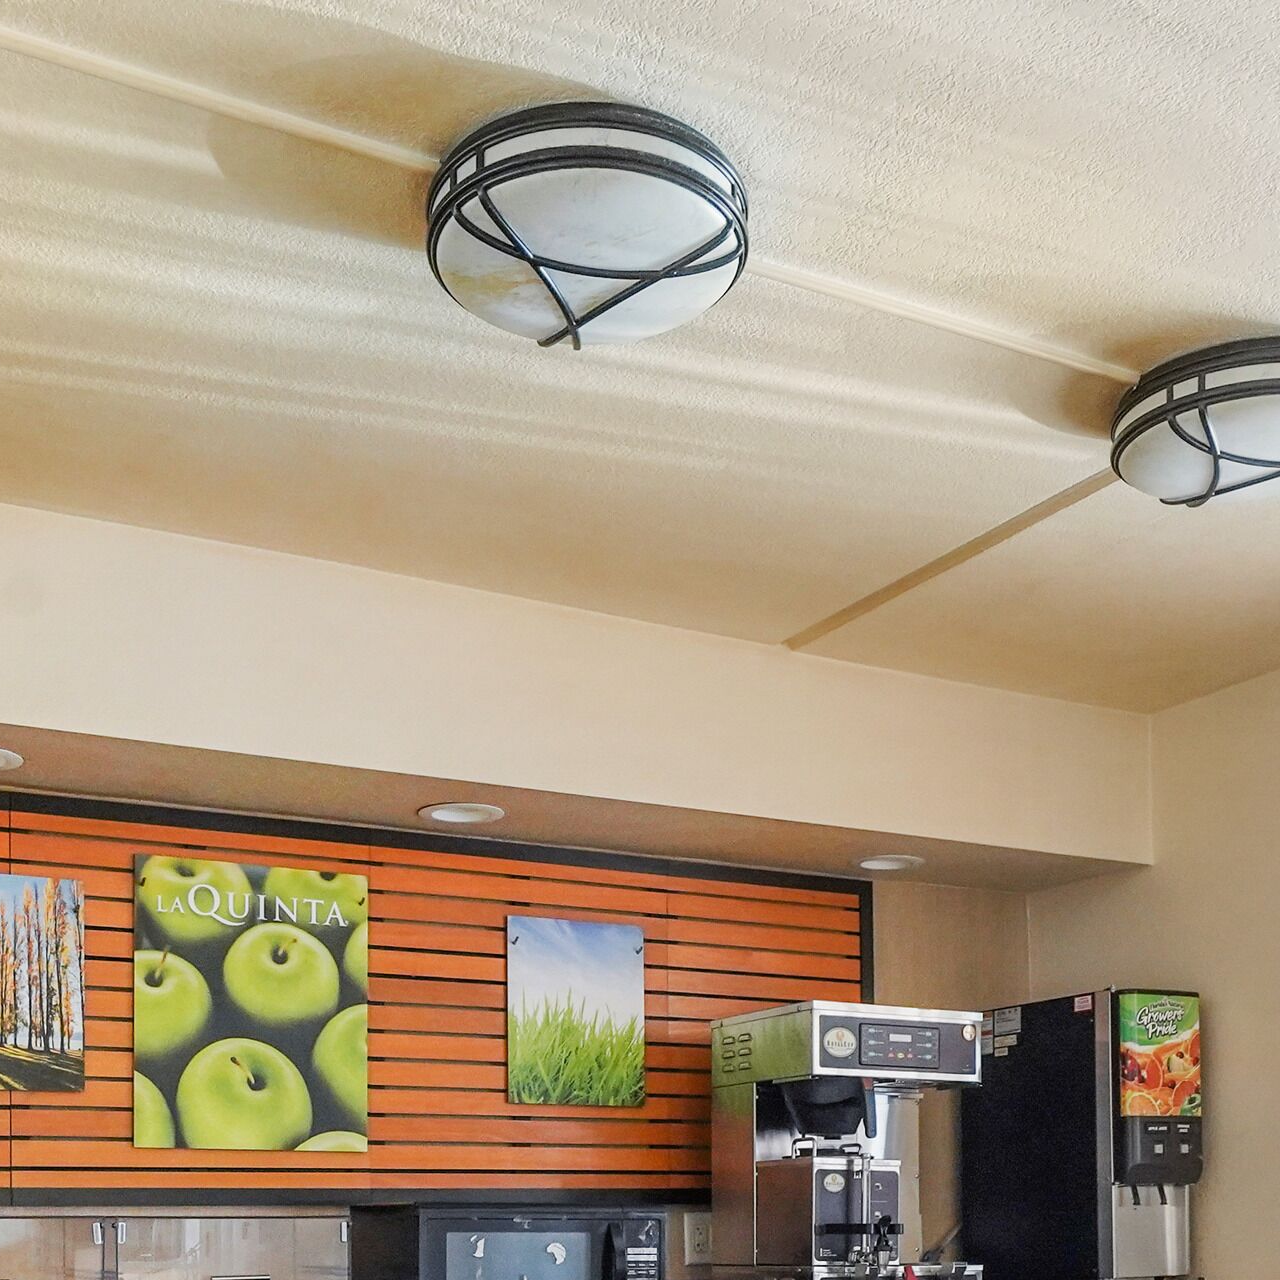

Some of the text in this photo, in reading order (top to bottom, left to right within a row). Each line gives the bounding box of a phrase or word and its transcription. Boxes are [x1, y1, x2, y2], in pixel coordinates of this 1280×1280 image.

[157, 884, 348, 927] LA QUINTA
[1146, 1020, 1177, 1039] Pride
